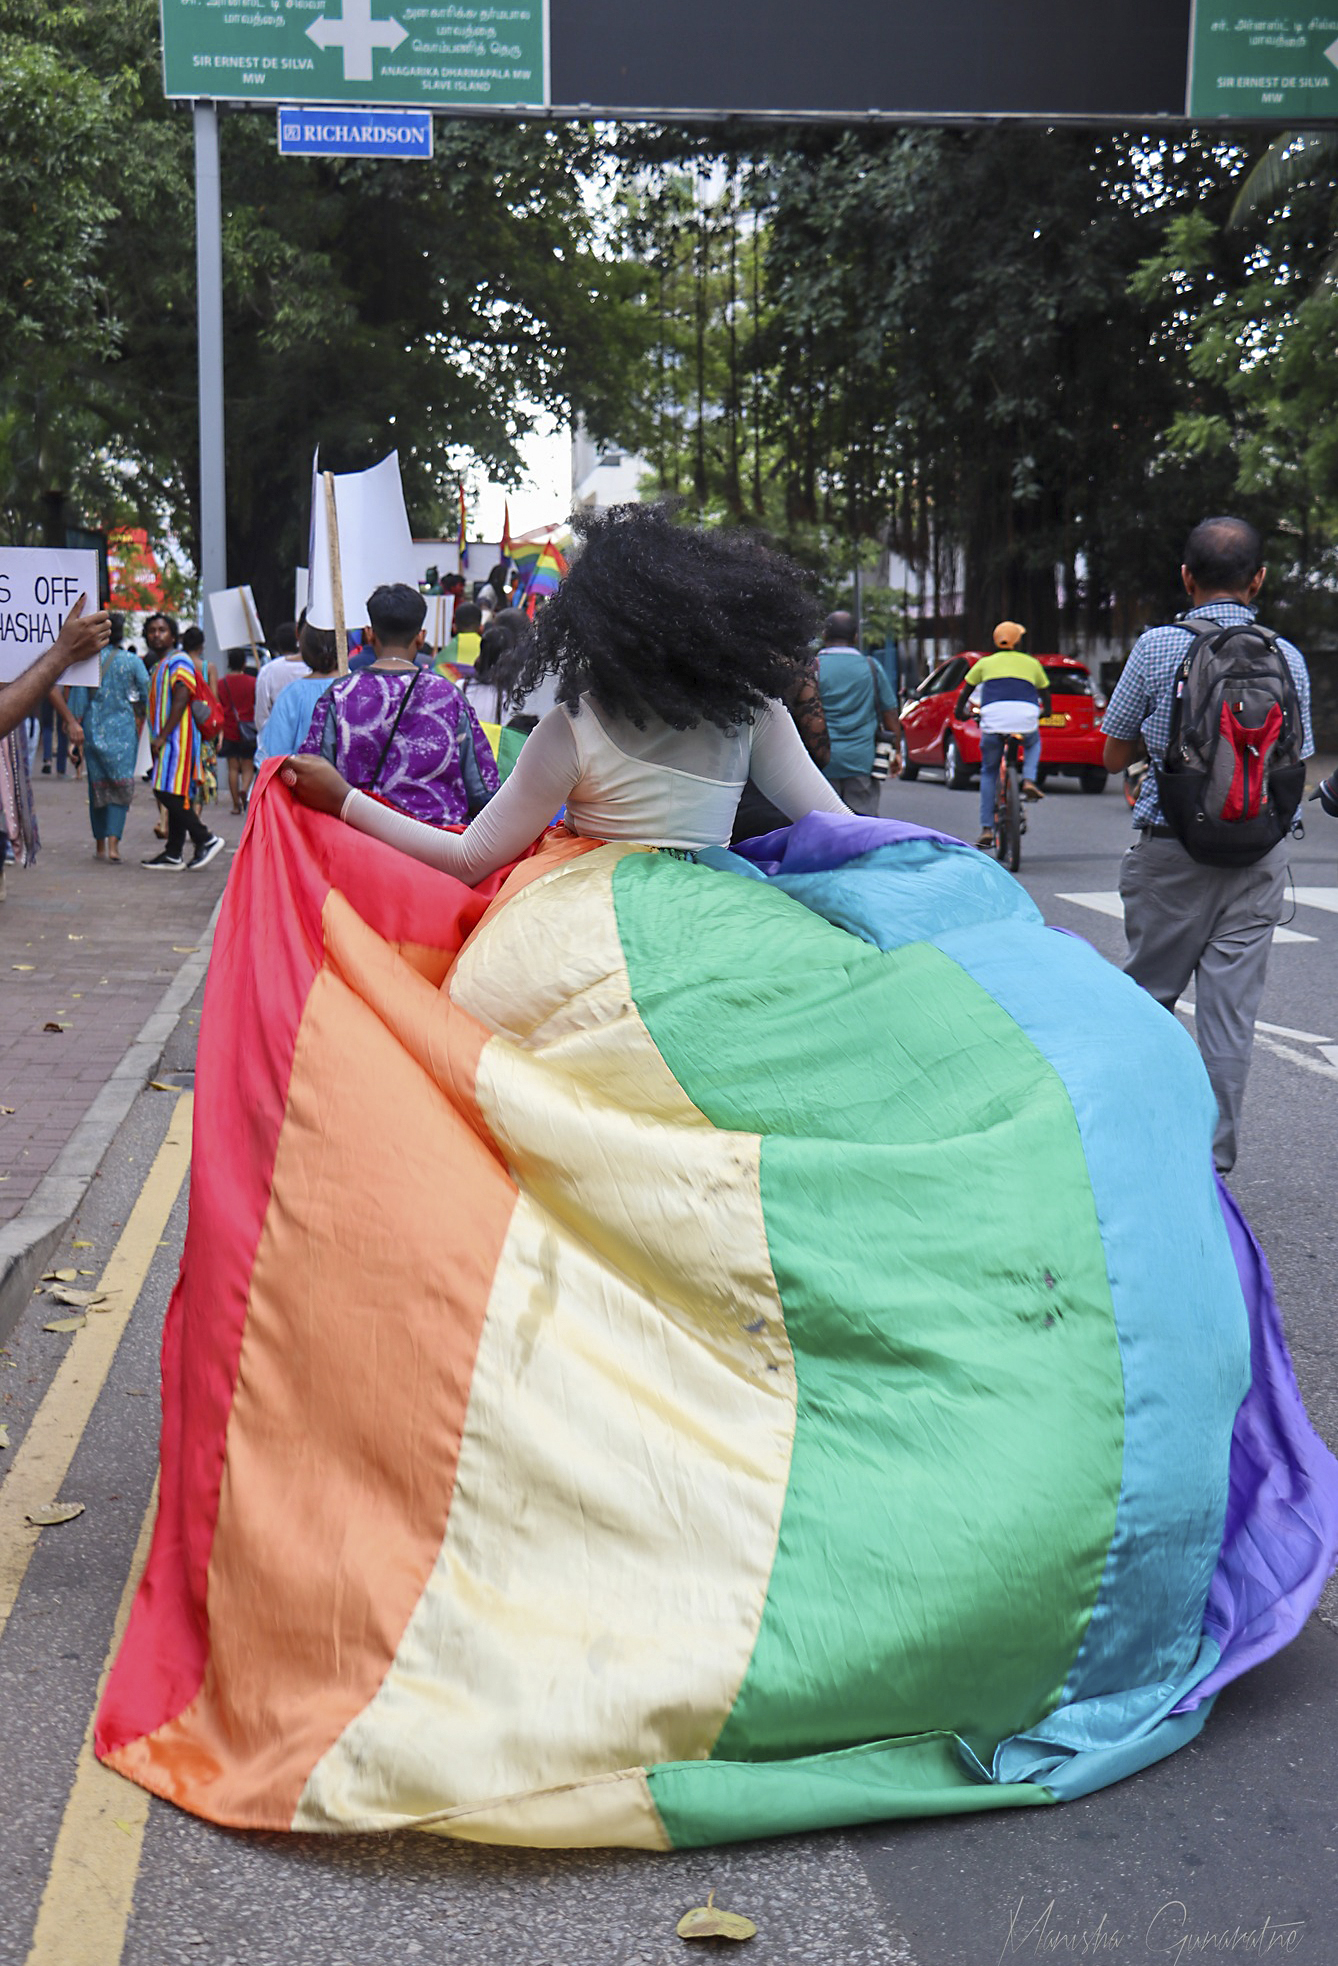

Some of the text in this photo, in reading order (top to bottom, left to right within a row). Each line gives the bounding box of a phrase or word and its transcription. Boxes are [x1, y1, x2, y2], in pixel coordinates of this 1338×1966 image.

[192, 55, 315, 70] SIR ERNEST DE SILVA
[242, 73, 266, 85] MW
[381, 66, 532, 81] ANAGARIKA DHARMAPALA MW
[422, 80, 492, 92] SLAVE ISLAND
[1216, 76, 1329, 88] SIR ERNEST DE SILVA
[1261, 92, 1284, 103] MW
[303, 124, 426, 145] RICHARDSON
[34, 576, 79, 606] OFF
